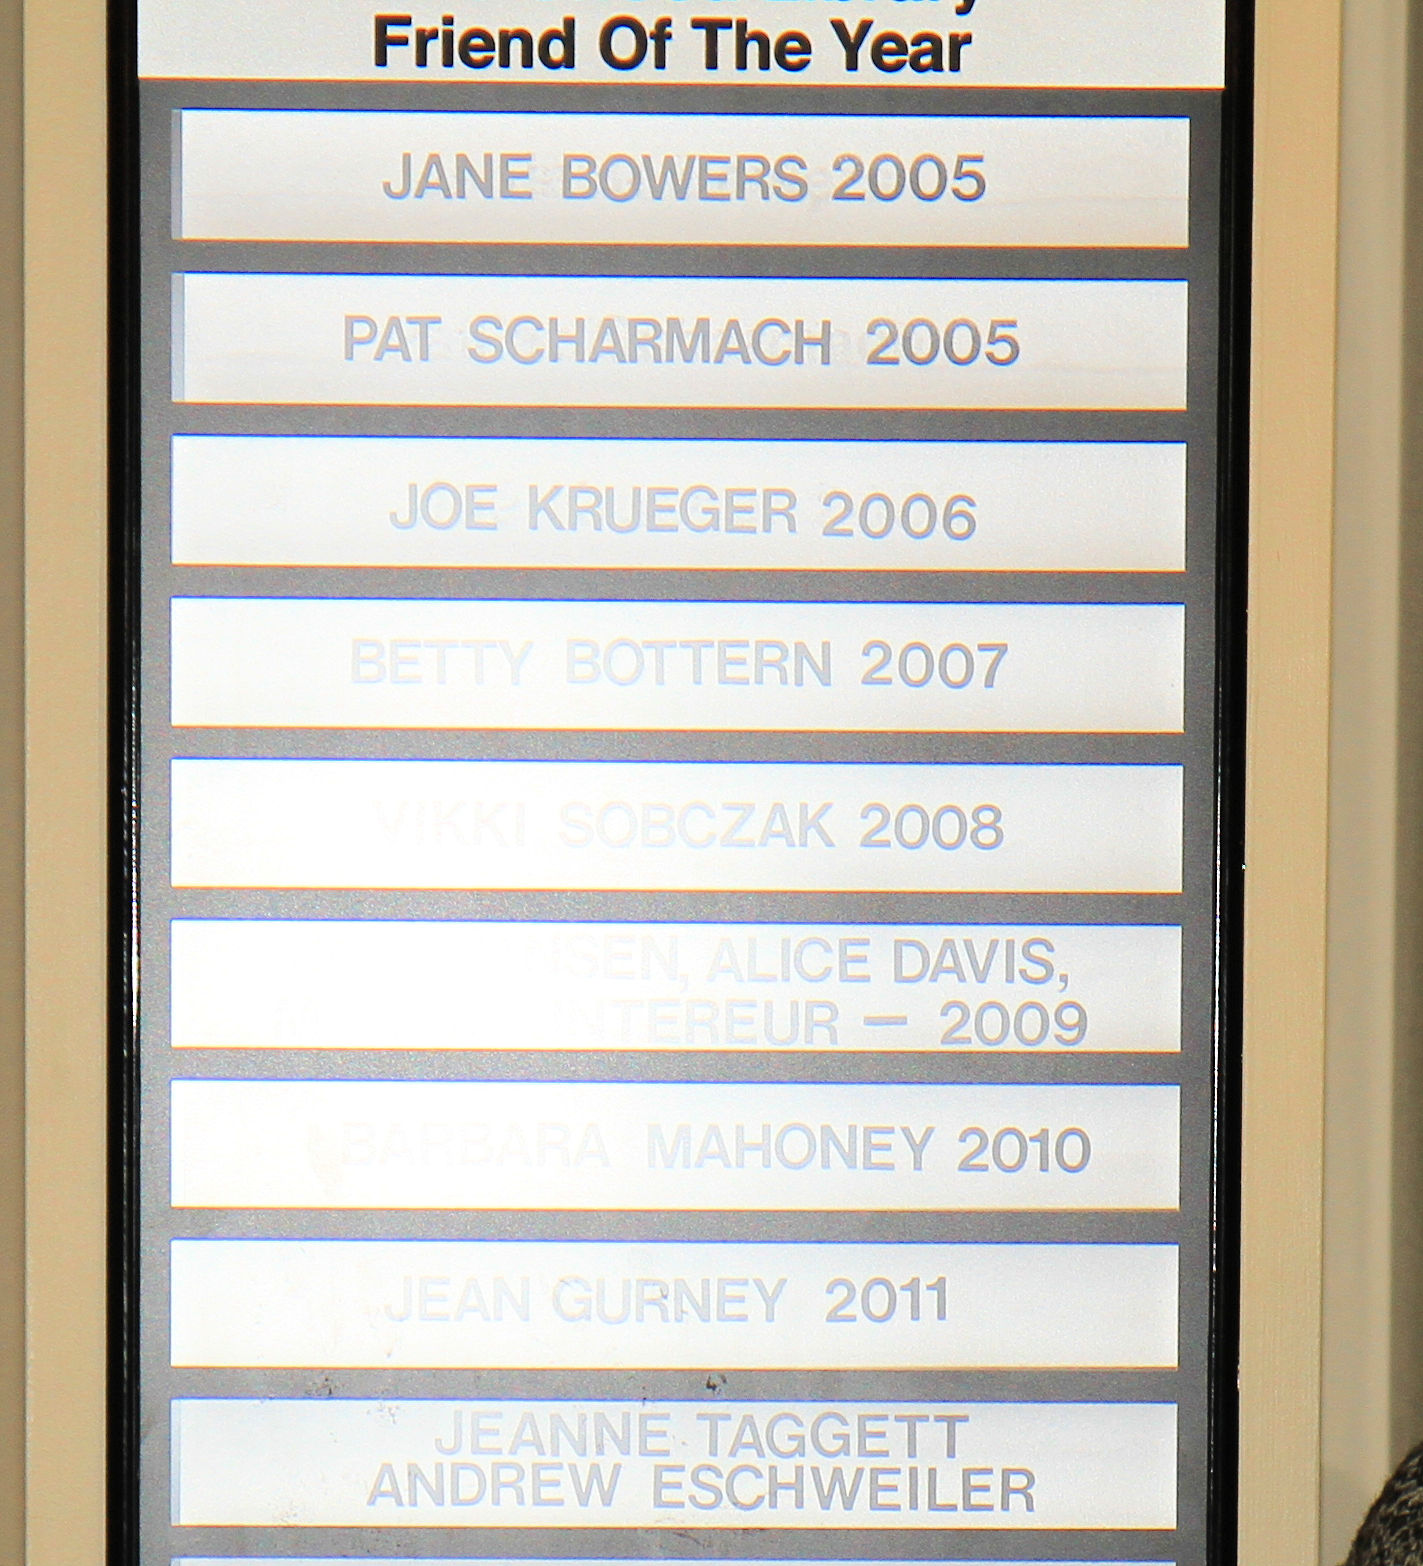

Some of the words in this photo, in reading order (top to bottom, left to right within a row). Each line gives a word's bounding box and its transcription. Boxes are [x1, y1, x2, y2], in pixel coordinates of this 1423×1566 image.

[374, 13, 577, 72] Friend
[598, 13, 675, 72] Of
[690, 13, 811, 74] The
[829, 16, 973, 74] Year
[382, 151, 534, 203] JANE
[561, 151, 809, 204] BOWERS
[830, 152, 988, 204] 2005
[343, 313, 439, 364] PAT
[467, 313, 832, 367] SCHARMACH
[865, 317, 1020, 368] 2005
[388, 480, 499, 533] JOE
[528, 480, 799, 537] KRUEGER
[821, 490, 978, 542] 2006
[351, 637, 535, 687] BETTY
[565, 637, 832, 689] BOTTERN
[859, 640, 1009, 692] 2007
[560, 801, 835, 851] SOBCZAK
[858, 802, 1004, 852] 2008
[708, 935, 871, 986] ALICE
[893, 936, 1071, 991] DAVIS,
[940, 999, 1088, 1048] 2009
[341, 1122, 610, 1170] BARBARA
[646, 1123, 934, 1173] MAHONEY
[956, 1125, 1092, 1175] 2010
[384, 1275, 533, 1325] JEAN
[551, 1275, 787, 1325] GURNEY
[824, 1275, 951, 1324] 2011
[434, 1409, 670, 1460] JEANNE
[696, 1411, 969, 1461] TAGGETT
[367, 1461, 623, 1509] ANDREW
[652, 1463, 1037, 1515] ESCHWEILER
